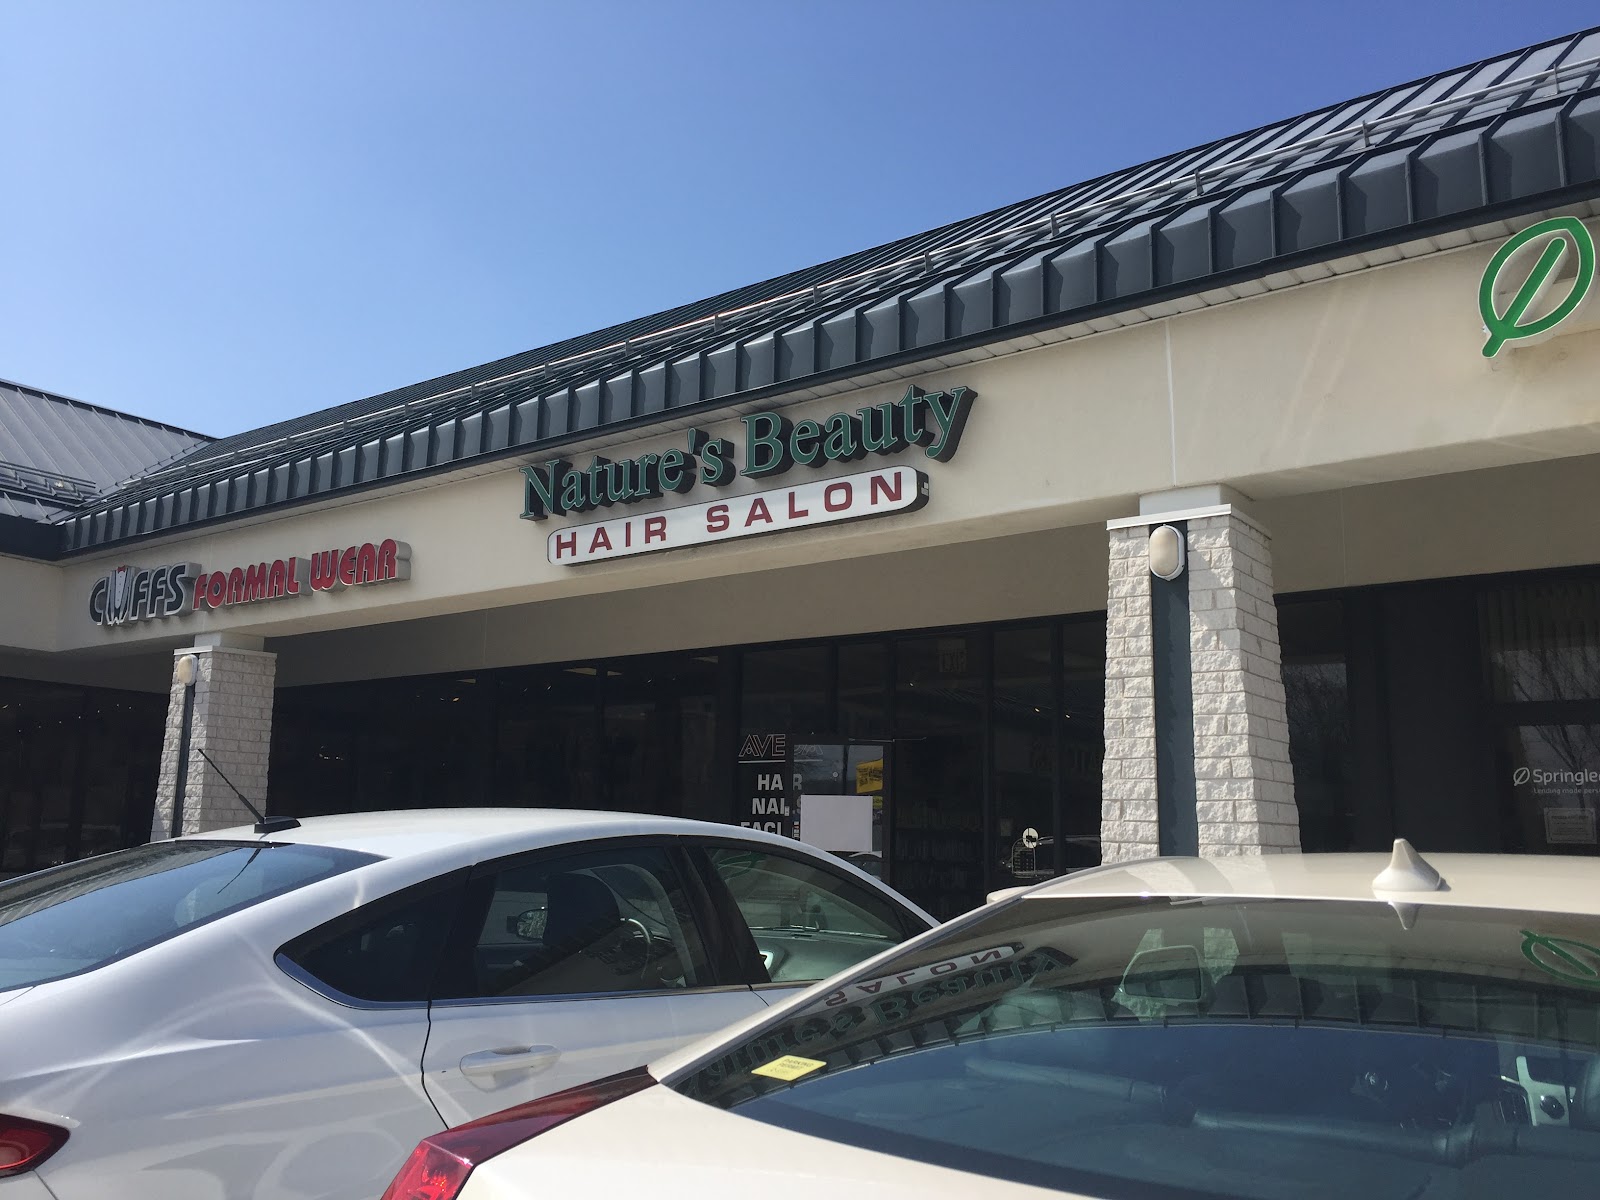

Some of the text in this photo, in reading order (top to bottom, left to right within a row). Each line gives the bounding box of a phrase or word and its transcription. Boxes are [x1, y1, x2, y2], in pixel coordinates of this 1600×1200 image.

[519, 384, 970, 520] Nature's Beauty
[555, 471, 903, 560] HAIR SALON
[89, 539, 399, 626] CUFFS FORMAL WEAR
[757, 773, 803, 791] HAR
